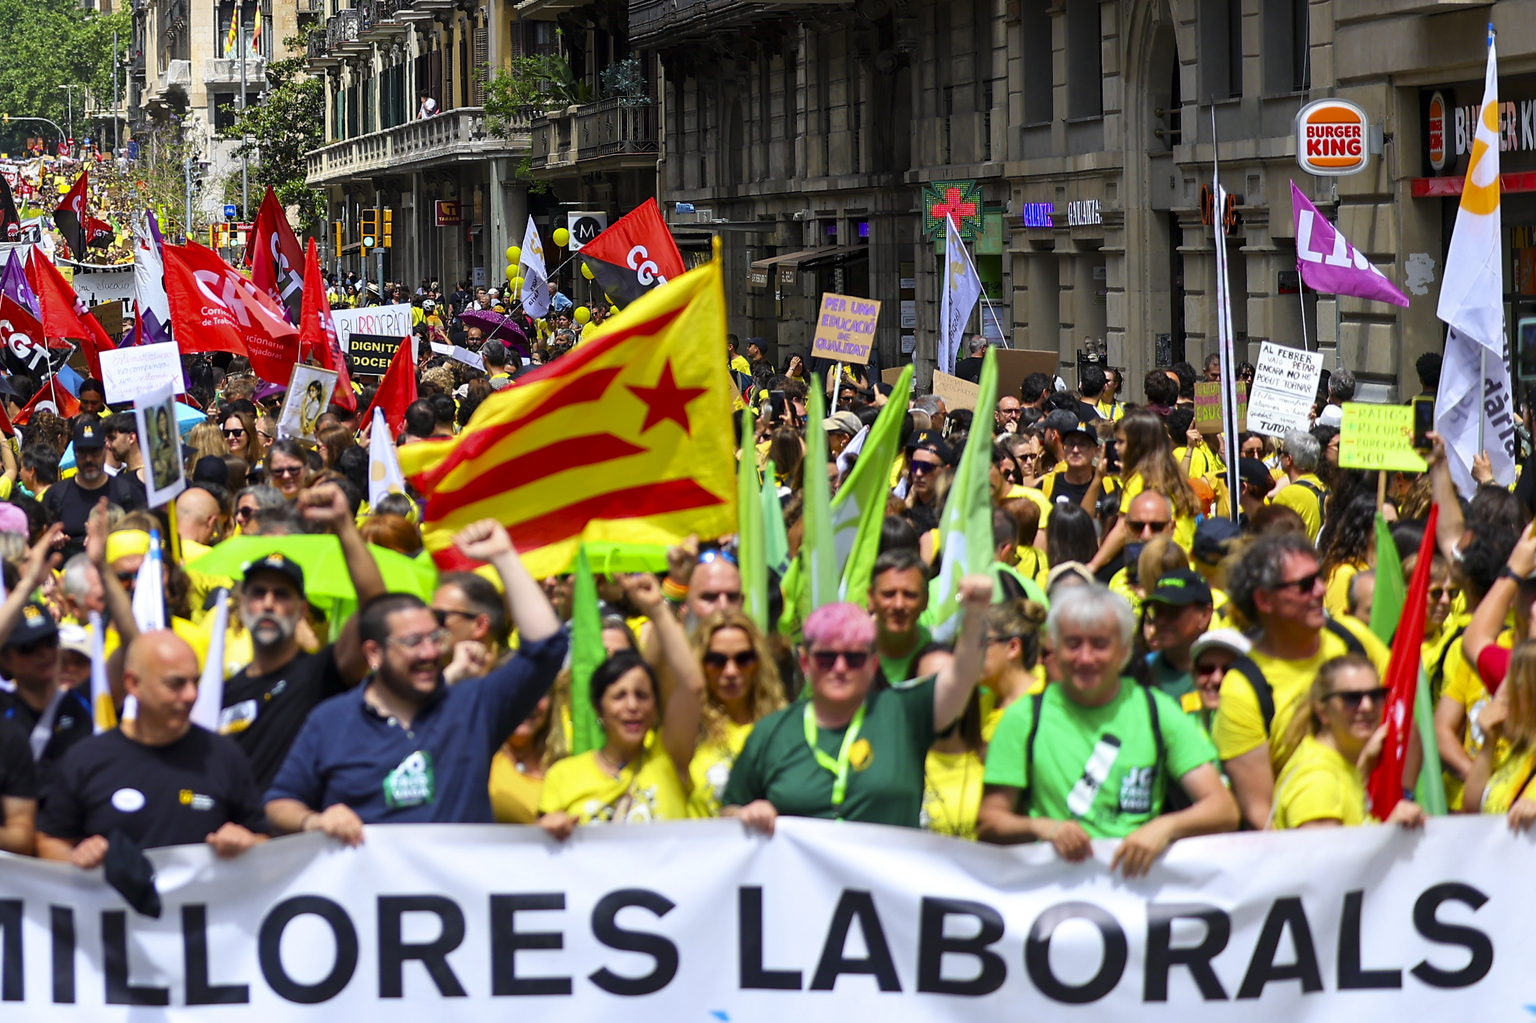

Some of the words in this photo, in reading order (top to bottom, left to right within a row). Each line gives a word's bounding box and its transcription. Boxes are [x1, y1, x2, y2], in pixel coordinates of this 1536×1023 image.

[1306, 125, 1362, 138] BURGER
[1455, 101, 1518, 156] BUER
[1306, 138, 1362, 156] KING
[825, 296, 847, 312] PER
[851, 301, 876, 317] UNA
[821, 314, 876, 335] EDUCACIÓ
[0, 319, 52, 371] CGT
[815, 337, 869, 357] QUALITAT
[837, 332, 851, 342] DE
[351, 341, 400, 354] DIGNITA
[1263, 344, 1273, 355] AL
[1277, 348, 1312, 364] FEBRER
[1258, 363, 1284, 376] ENCARA
[1287, 370, 1301, 380] NO
[1302, 373, 1312, 381] HE
[1256, 374, 1280, 387] POGUT
[1283, 379, 1312, 394] TORNAR
[1358, 407, 1407, 422] RATIOS
[737, 880, 1495, 1005] LABORALS
